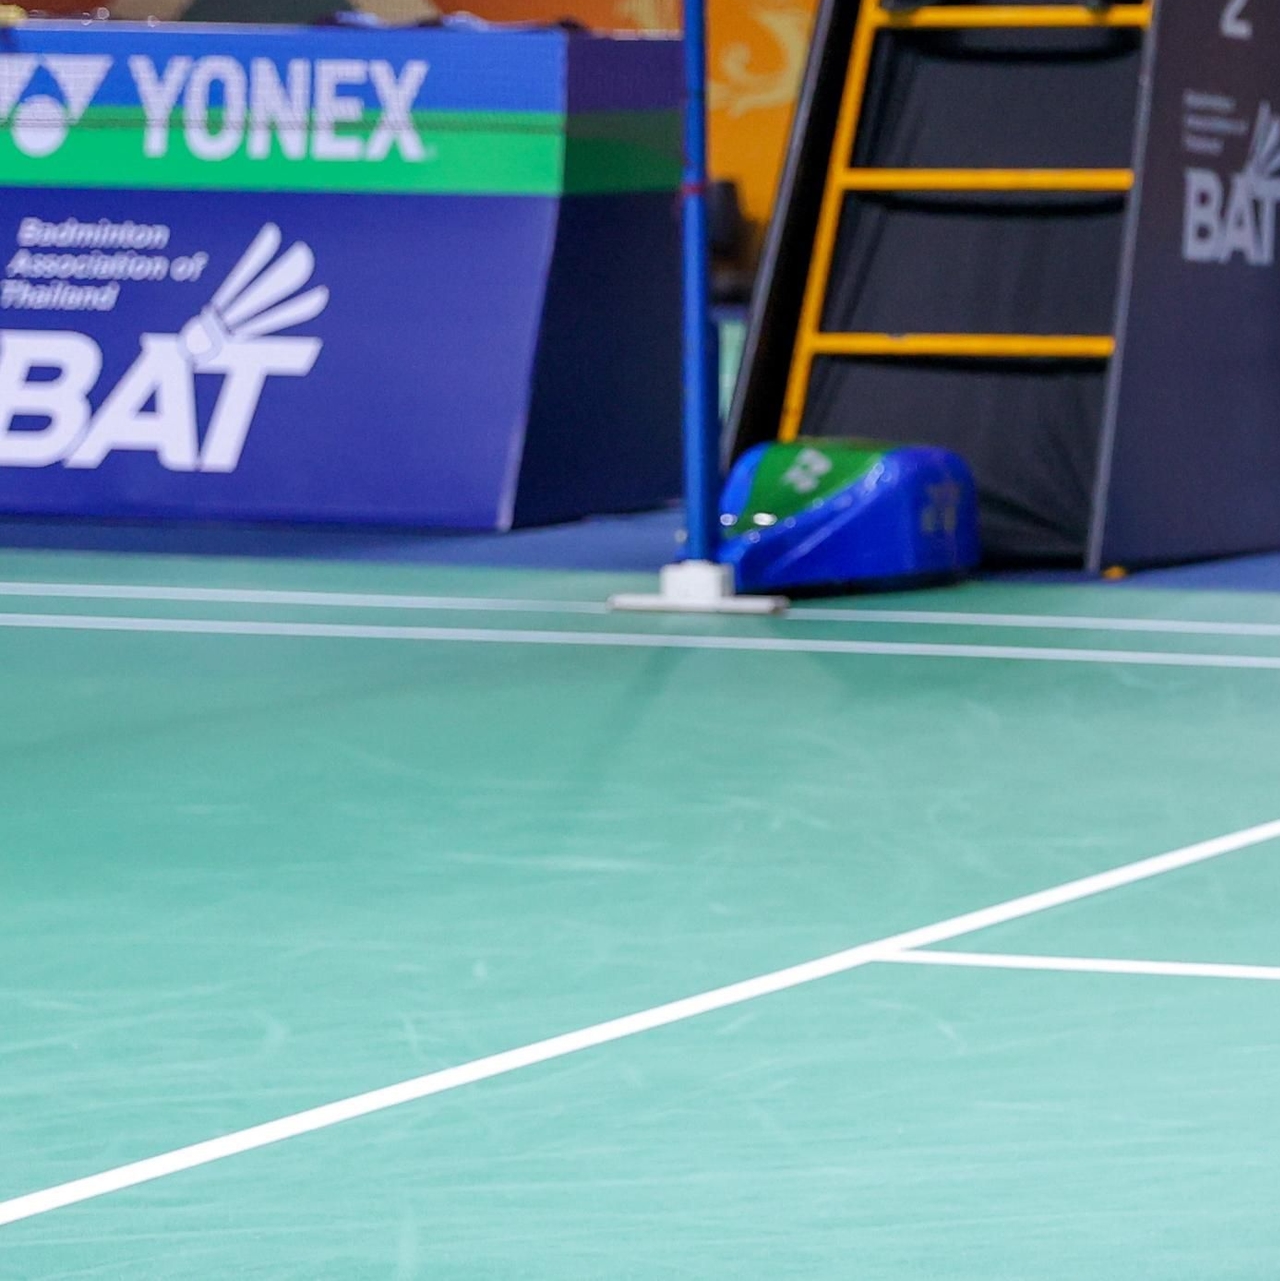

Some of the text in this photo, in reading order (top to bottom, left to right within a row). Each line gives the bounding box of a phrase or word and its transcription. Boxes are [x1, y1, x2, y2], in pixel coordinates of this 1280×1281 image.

[127, 54, 431, 162] YONEX
[17, 217, 170, 250] Badminton
[6, 248, 209, 282] Association of
[0, 278, 120, 311] Thailand
[0, 329, 324, 474] BAT
